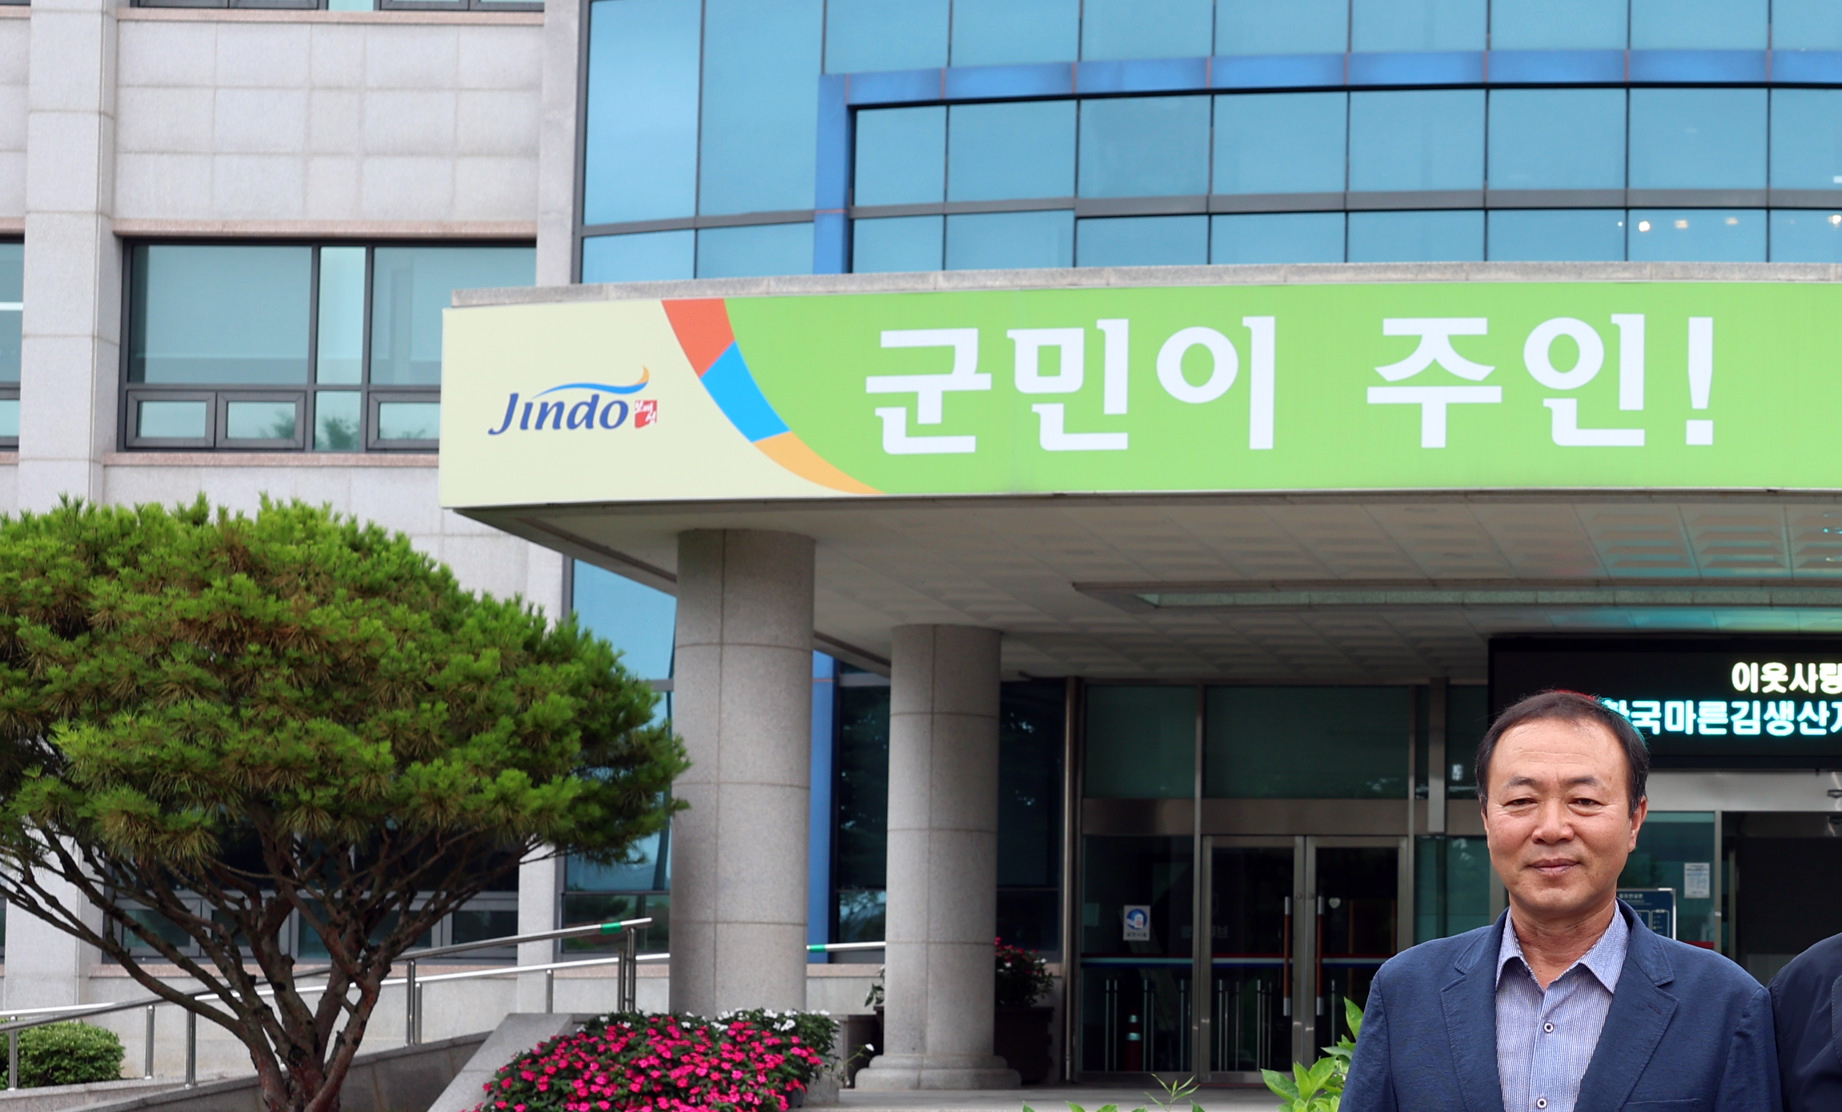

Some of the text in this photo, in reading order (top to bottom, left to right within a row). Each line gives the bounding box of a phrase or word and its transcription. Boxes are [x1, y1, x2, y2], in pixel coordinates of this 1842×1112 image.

[488, 392, 629, 435] Jindo
[867, 317, 1274, 453] 군민이
[1368, 315, 1712, 447] 주인!
